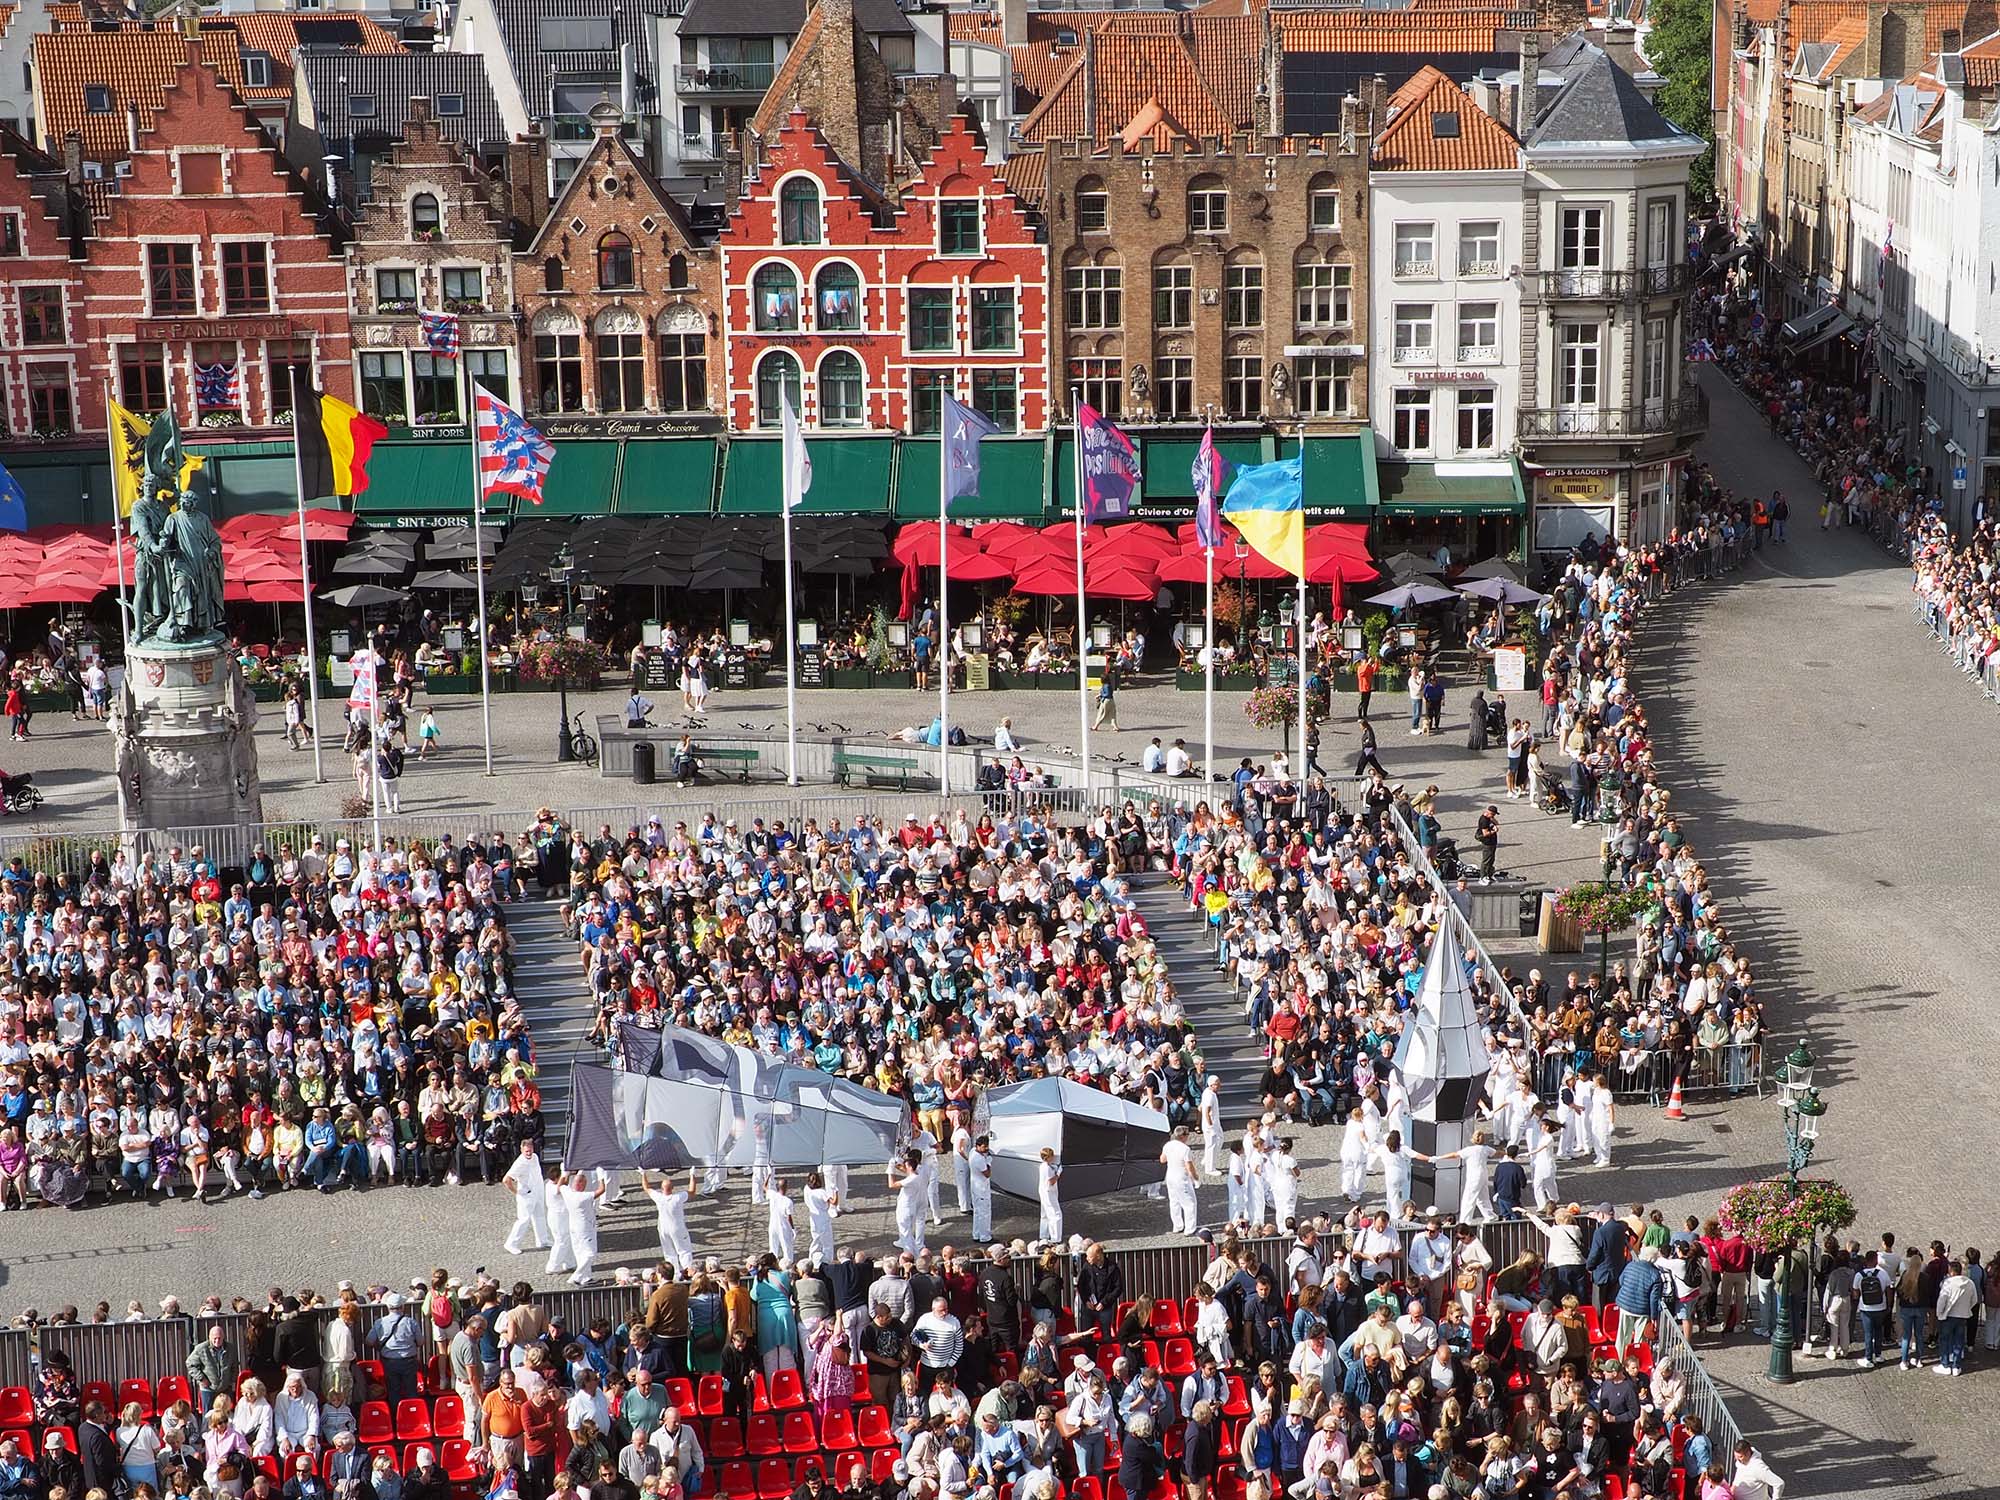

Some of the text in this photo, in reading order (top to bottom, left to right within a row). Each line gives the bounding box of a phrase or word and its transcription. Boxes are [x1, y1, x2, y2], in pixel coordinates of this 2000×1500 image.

[171, 323, 239, 338] PANIER
[1408, 371, 1485, 382] FRITERIE 1900
[656, 420, 701, 433] Brasserie
[412, 428, 465, 438] SINT JORIS
[1173, 507, 1194, 516] d'Or
[1323, 506, 1345, 515] café
[397, 516, 469, 528] SINT-JORIS
[478, 519, 506, 527] rasserie
